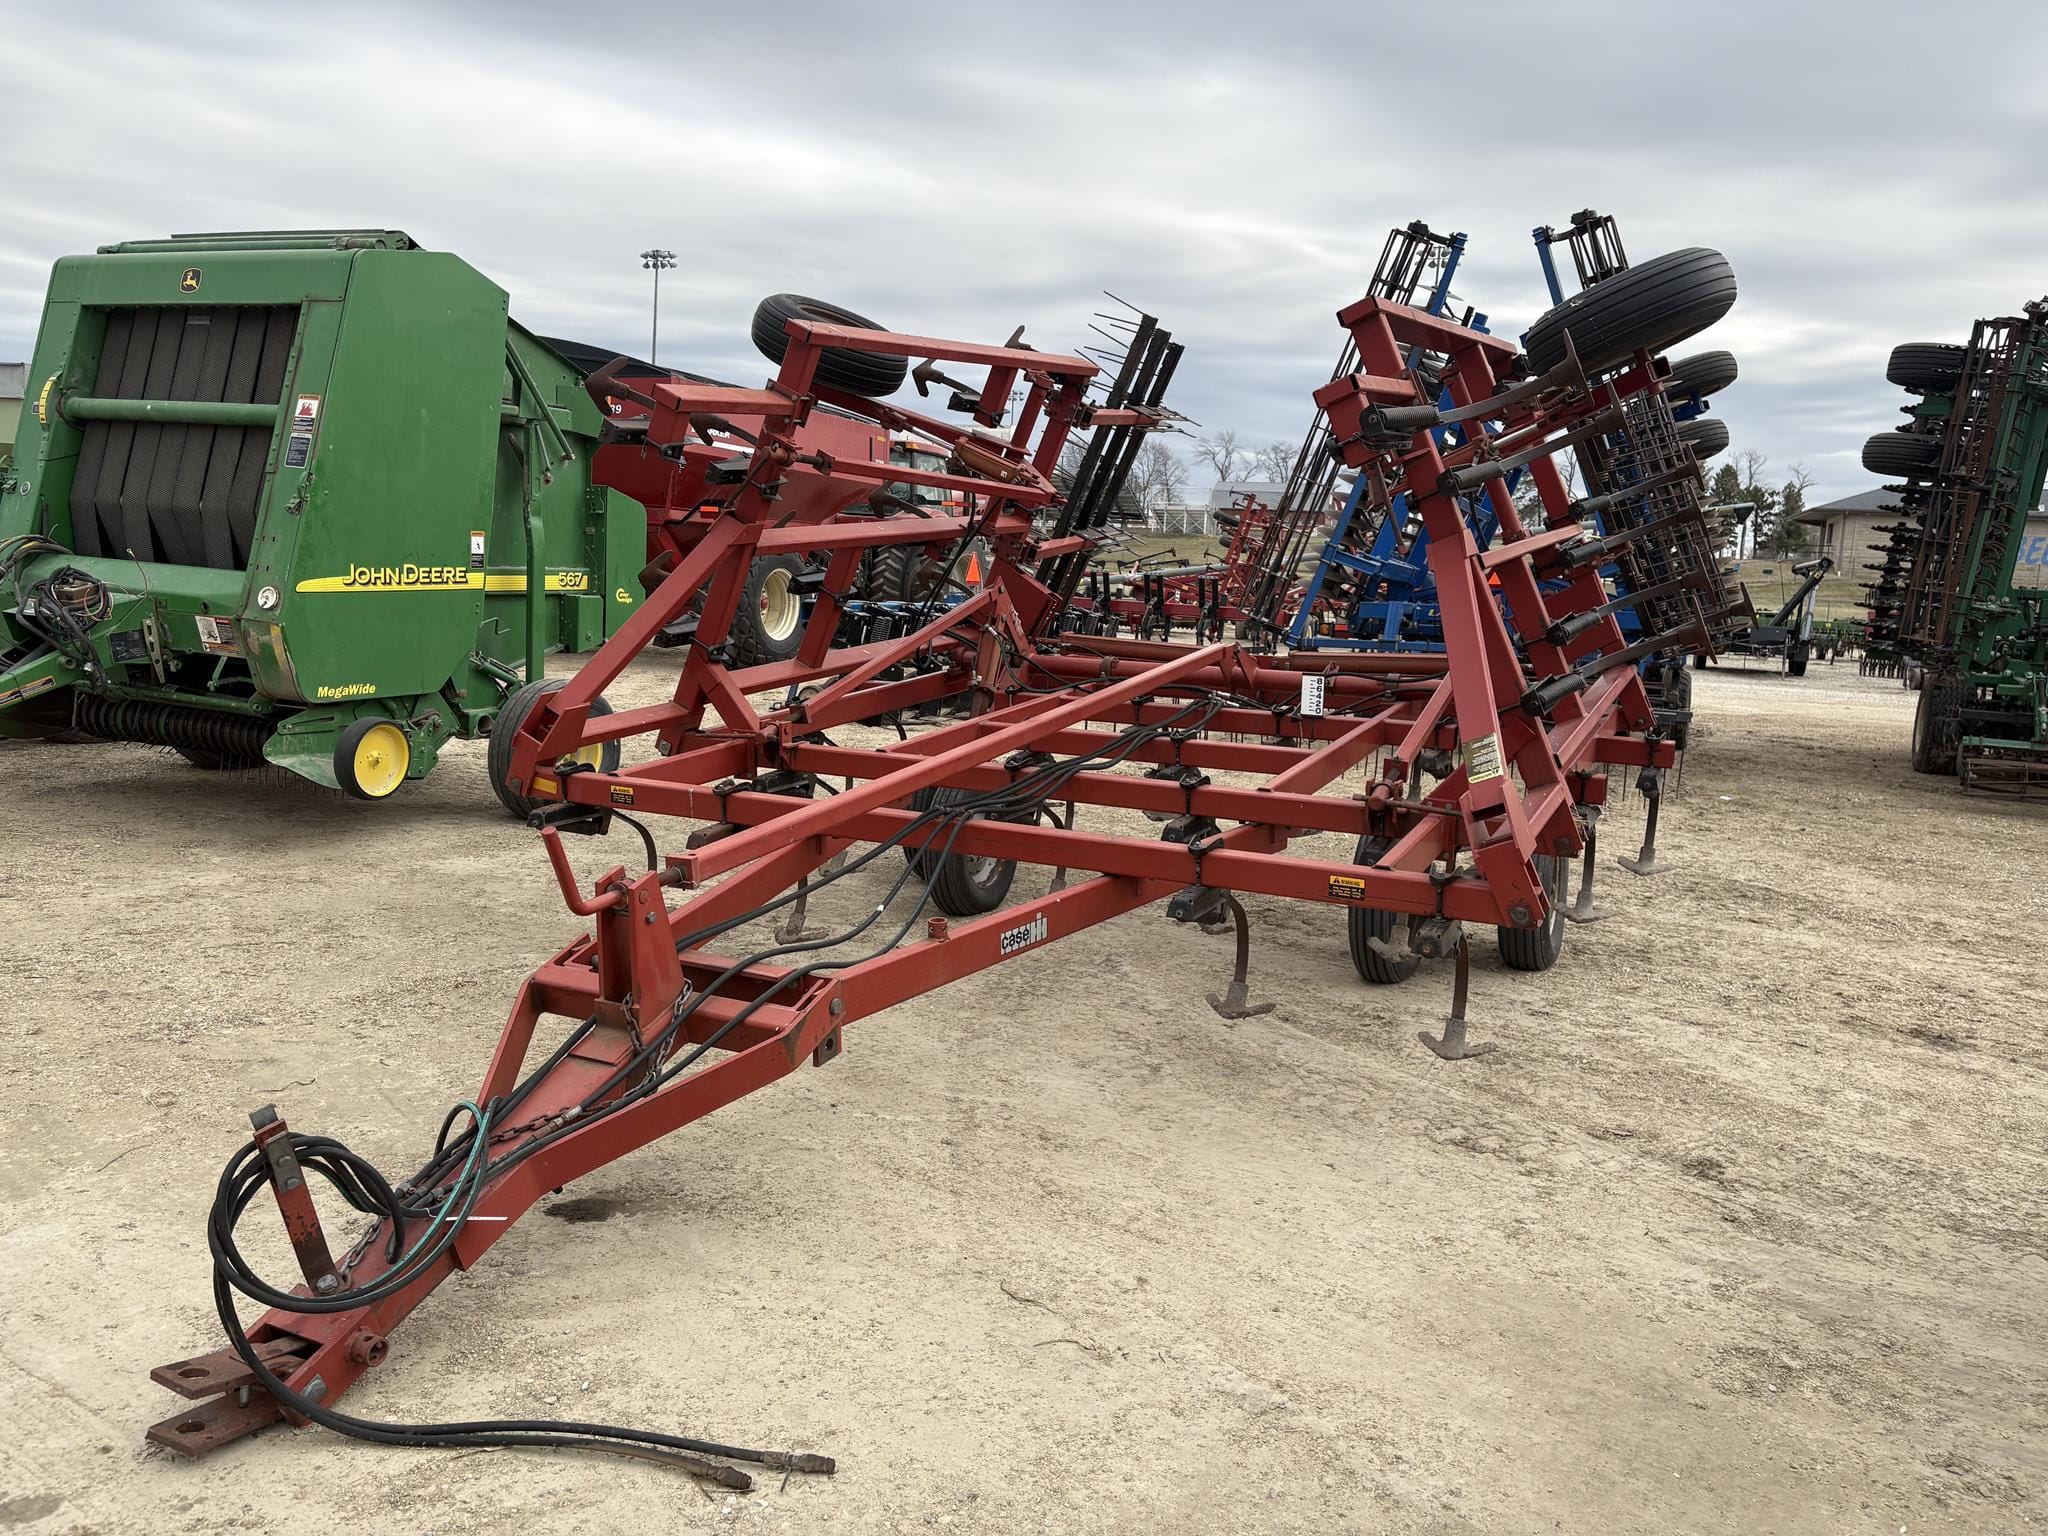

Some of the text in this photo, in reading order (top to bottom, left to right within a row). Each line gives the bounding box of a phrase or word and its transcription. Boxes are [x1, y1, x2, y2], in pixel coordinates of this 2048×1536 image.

[343, 563, 468, 586] JOHN DEERE
[558, 572, 583, 586] 567
[1316, 677, 1323, 685] 8
[317, 683, 376, 699] MegaWide
[1316, 685, 1323, 693] 6
[1315, 707, 1322, 715] 0
[1002, 928, 1029, 949] case
